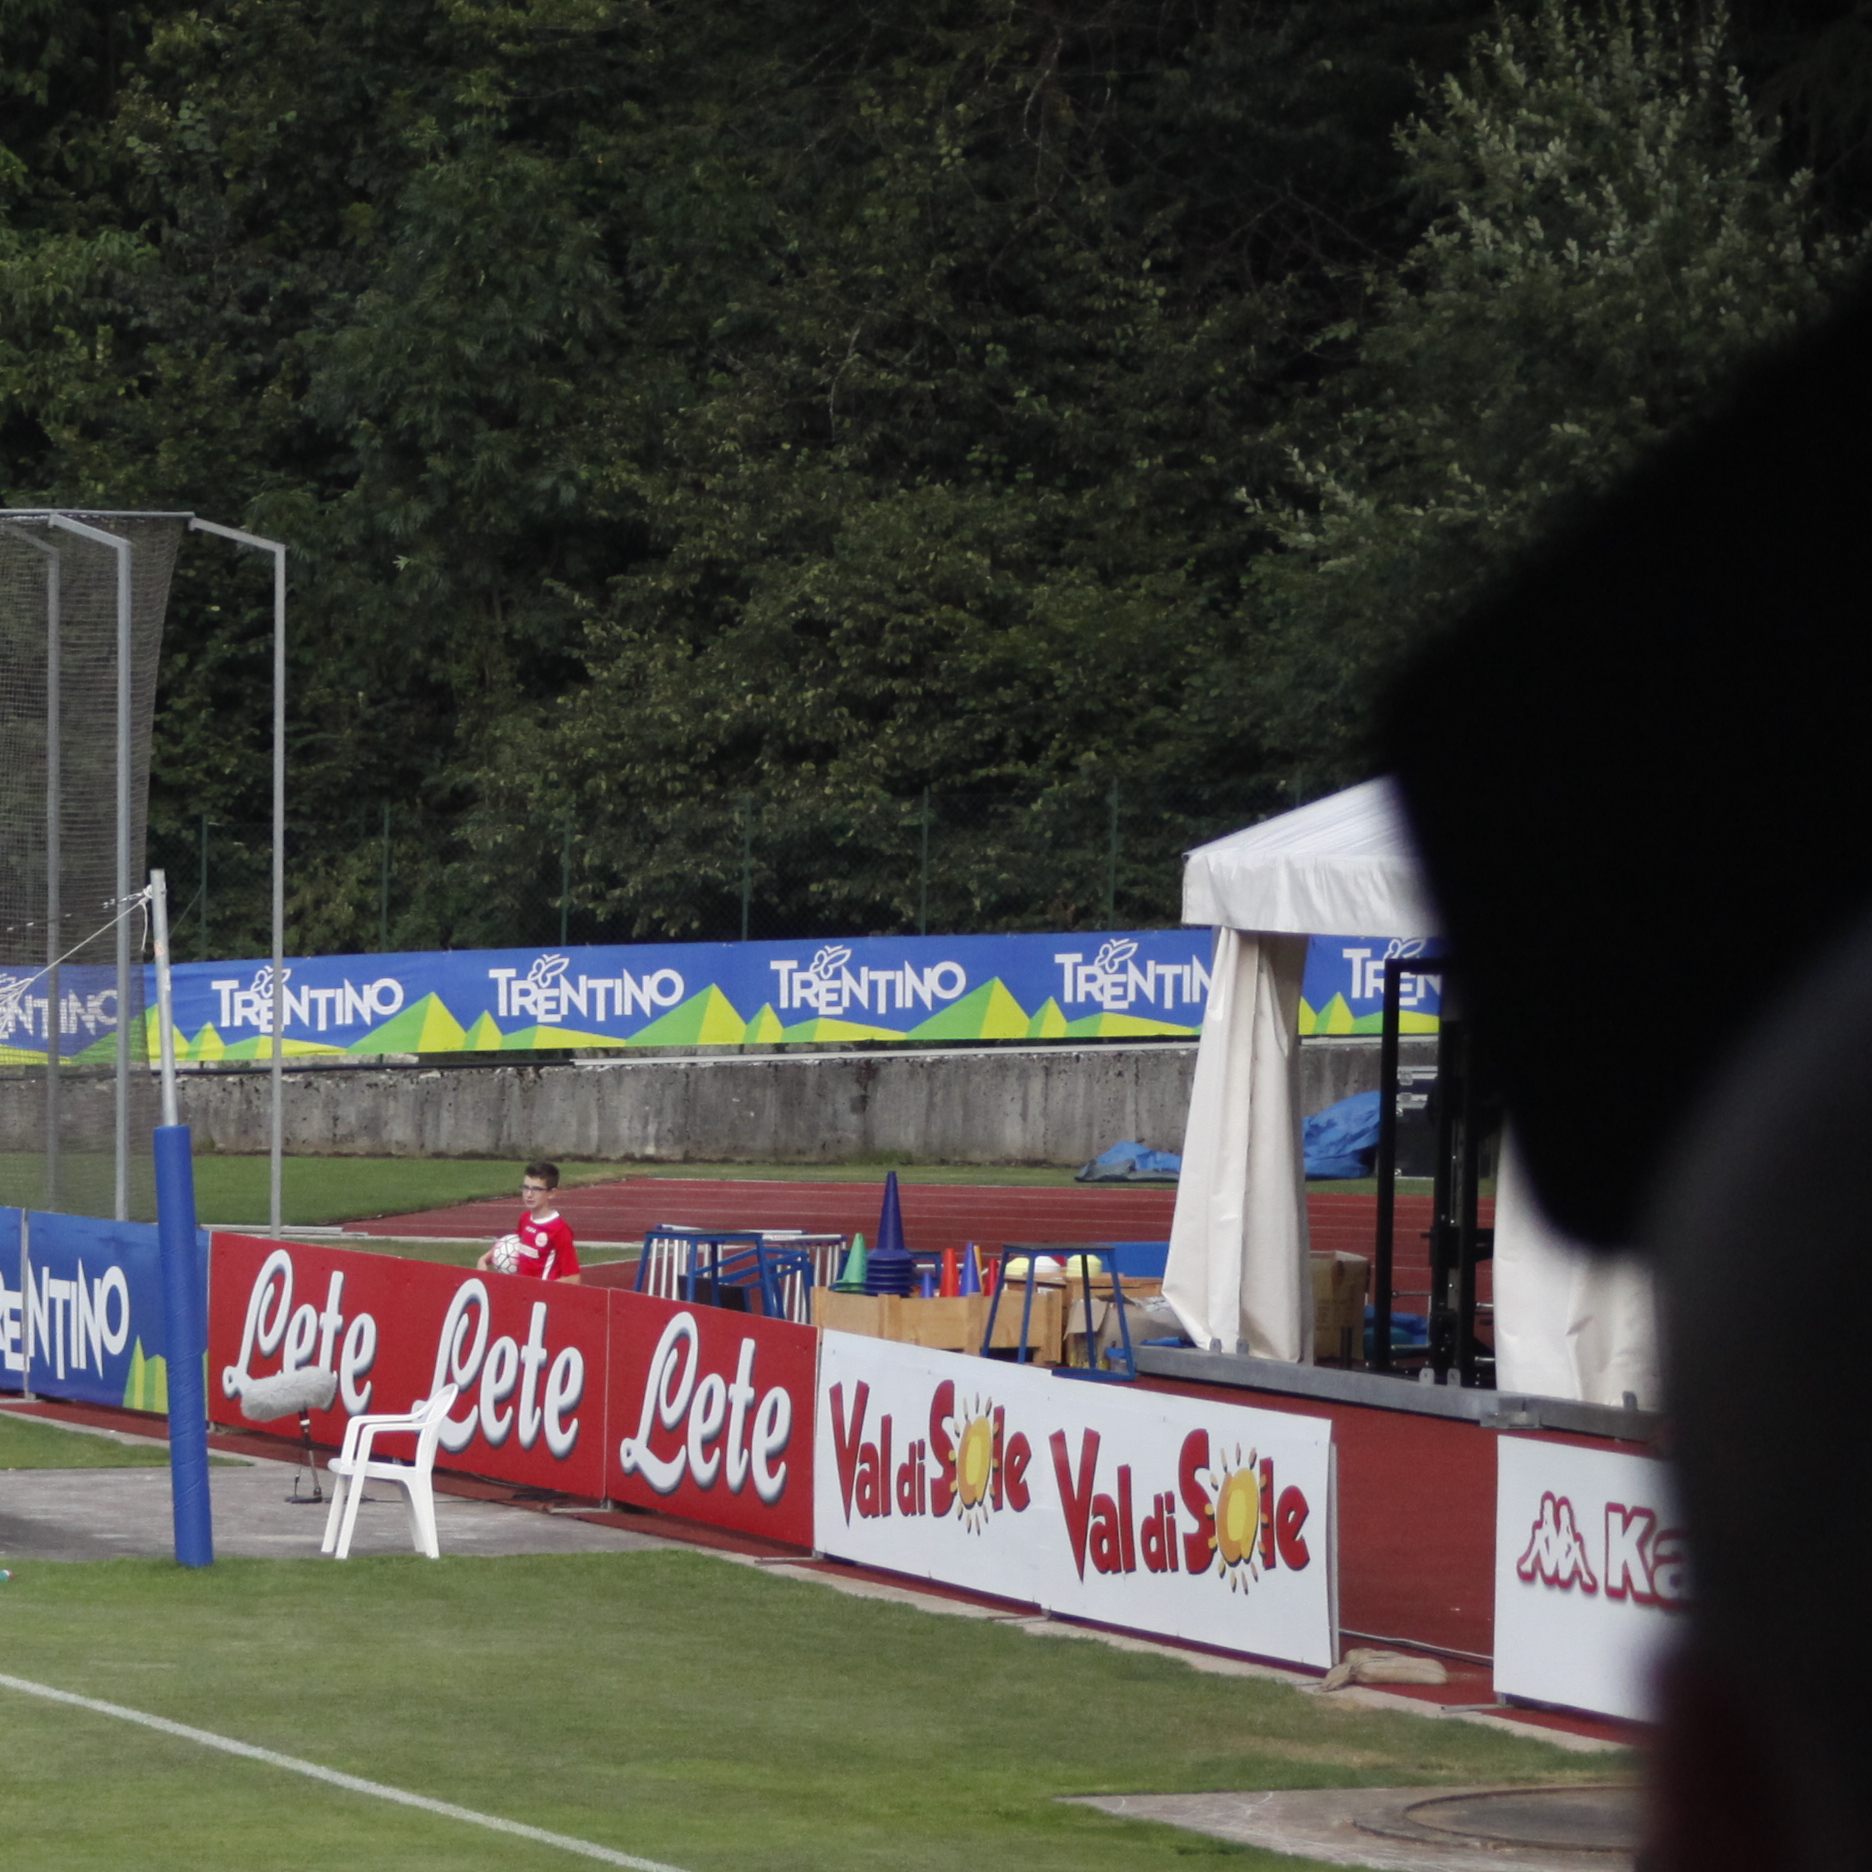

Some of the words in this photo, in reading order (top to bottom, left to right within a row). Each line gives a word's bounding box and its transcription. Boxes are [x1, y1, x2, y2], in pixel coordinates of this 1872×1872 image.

[211, 977, 403, 1034] TRENTINO
[489, 967, 684, 1023] TRENTINO
[770, 959, 966, 1015] TRENTINO
[1054, 952, 1212, 1010] TRENTIN
[222, 1249, 377, 1417] Lete
[411, 1278, 584, 1461] Lete
[620, 1312, 792, 1506] Lete
[829, 1379, 892, 1529] Val
[896, 1438, 926, 1517] di
[929, 1379, 1032, 1525] Sole
[1049, 1427, 1136, 1585] Val
[1140, 1490, 1179, 1574] di
[1179, 1428, 1310, 1580] Sole
